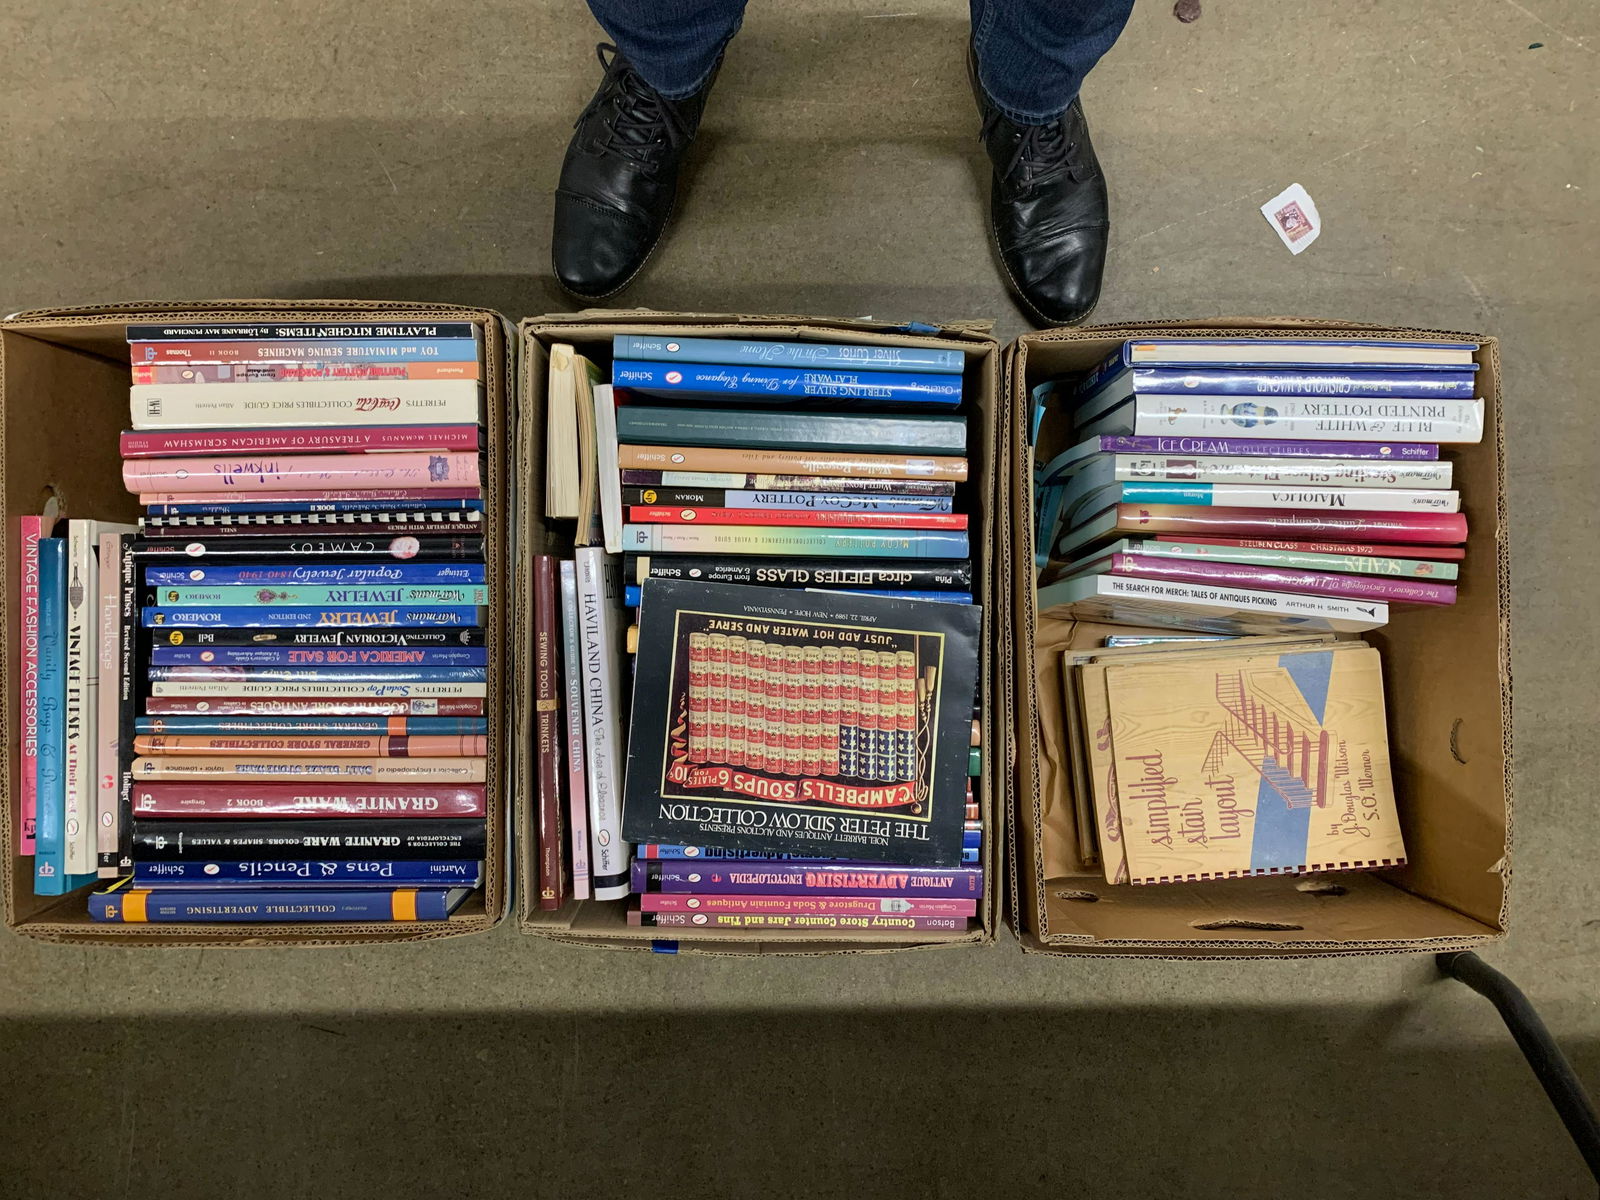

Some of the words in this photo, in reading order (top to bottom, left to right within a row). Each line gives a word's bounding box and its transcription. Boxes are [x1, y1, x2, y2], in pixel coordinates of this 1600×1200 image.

[276, 328, 316, 337] ITEMS:
[319, 328, 372, 336] KITCHEN
[376, 327, 436, 336] PLAYTIME
[308, 347, 343, 356] SEWING
[347, 347, 398, 356] MINIATURE
[402, 347, 417, 355] and
[420, 347, 439, 355] TOY
[633, 342, 662, 350] Schiffer
[166, 349, 191, 357] Thomas
[258, 348, 305, 357] MACHINES
[620, 371, 653, 381] Schiffer
[804, 374, 858, 384] FLATWARE
[804, 385, 837, 395] SILVER
[840, 386, 892, 397] STERLING
[911, 382, 953, 394] Osterberg
[244, 401, 269, 409] GUIDE
[295, 399, 352, 408] COLLECTIBLES
[1300, 402, 1372, 416] POTTERY
[1378, 406, 1445, 417] PRINTED
[1316, 419, 1367, 431] WHITE
[164, 439, 227, 448] SCRIMSHAW
[231, 438, 287, 446] AMERICAN
[290, 437, 304, 445] OF
[307, 436, 360, 444] TREASURY
[1158, 437, 1179, 452] ICE
[1180, 436, 1229, 453] CREAM
[637, 453, 666, 461] Schiffer
[1402, 447, 1429, 456] Schiffer
[213, 462, 280, 485] inkwells
[1401, 471, 1442, 481] Warman's
[752, 494, 816, 507] POTTERY
[1272, 493, 1345, 507] MAJOLICA
[1411, 498, 1449, 507] Warman's
[290, 542, 375, 553] CAMEOS
[1240, 540, 1272, 549] STEUBEN
[1273, 542, 1298, 550] GLASS
[1311, 543, 1354, 552] CHRISTMAS
[25, 534, 37, 594] VINTAGE
[1345, 556, 1402, 575] SCALES
[293, 567, 345, 580] Jewelry
[348, 568, 402, 580] Popular
[650, 568, 681, 577] Schiffer
[708, 572, 732, 581] Europe
[756, 568, 809, 582] GLASS
[1341, 580, 1385, 593] Encyclopedia
[1389, 586, 1424, 597] Collector's
[326, 588, 404, 602] JEWELRY
[1113, 582, 1125, 591] THE
[1126, 583, 1148, 593] SEARCH
[1151, 585, 1164, 594] FOR
[1166, 587, 1188, 598] MERCH:
[1190, 590, 1208, 599] TALES
[1211, 592, 1218, 600] OF
[1220, 592, 1250, 603] ANTIQUES
[1251, 596, 1277, 606] PICKING
[1426, 590, 1439, 598] The
[743, 605, 787, 615] PENNSYLVANIA
[1286, 601, 1315, 610] ARTHUR
[1327, 605, 1349, 613] SMITH
[173, 613, 221, 622] ROMERO
[319, 610, 398, 626] JEWELRY
[26, 597, 37, 657] FASHION
[102, 594, 117, 669] Handbags
[745, 623, 770, 634] AND
[772, 625, 809, 638] WATER
[198, 633, 214, 643] Bell
[584, 593, 600, 673] HAVILAND
[813, 629, 834, 639] HOT
[837, 632, 861, 643] ADD
[539, 632, 548, 667] SEWING
[68, 626, 81, 685] VINTAGE
[289, 651, 325, 662] SALE
[328, 651, 356, 662] FOR
[360, 651, 425, 662] AMERICA
[540, 670, 548, 698] TOOLS
[570, 679, 581, 735] SOUVENIR
[588, 677, 603, 726] CHINA
[26, 661, 37, 756] ACCESSORIES
[68, 688, 81, 739] PURSES
[39, 697, 57, 733] Bags
[541, 714, 549, 753] TRINKETS
[210, 740, 285, 749] COLLECTIBLES
[288, 741, 321, 749] STORE
[325, 741, 370, 749] GENERAL
[572, 739, 582, 772] CHINA
[1335, 740, 1350, 778] Wilson
[69, 757, 78, 786] Their
[1360, 749, 1372, 789] Werner
[719, 771, 728, 787] 6
[734, 775, 795, 799] SOUPS
[803, 781, 910, 807] CAMPBELL'S
[355, 797, 438, 810] GRANITE
[1126, 750, 1179, 850] simplified
[1343, 781, 1360, 822] Douglas
[1205, 775, 1255, 839] layout
[1362, 793, 1380, 820] S.O.
[659, 804, 766, 826] COLLECTION
[771, 811, 835, 832] SIDLOW
[840, 817, 890, 837] PETER
[1177, 798, 1208, 848] stair
[699, 824, 736, 833] PRESENTS
[737, 827, 774, 838] AUCTIONS
[776, 829, 794, 839] AND
[895, 822, 930, 840] THE
[1327, 824, 1343, 835] by
[1345, 822, 1370, 837] J.
[345, 836, 400, 847] GRANITE
[795, 830, 833, 842] ANTIQUES
[834, 832, 867, 844] BARRETT
[869, 834, 889, 845] NOEL
[303, 837, 340, 847] WARE
[149, 863, 185, 876] Schiffer
[239, 862, 310, 876] Pencils
[344, 862, 393, 876] Pens
[430, 864, 467, 875] Martini
[729, 873, 802, 884] ENCYCLOPEDIA
[806, 872, 908, 889] ADVERTISING
[911, 876, 953, 887] ANTIQUE
[266, 905, 336, 913] COLLECTIBLE
[707, 898, 748, 909] Antiques
[750, 900, 791, 909] Fountain
[794, 901, 817, 909] Soda
[829, 899, 875, 910] Drugstore
[186, 906, 258, 914] ADVERTISING
[652, 914, 685, 924] Schiffer
[717, 916, 742, 925] Tins
[744, 916, 764, 925] and
[767, 916, 791, 926] Jars
[793, 916, 836, 926] Counter
[840, 917, 868, 926] Store
[871, 916, 915, 928] Country
